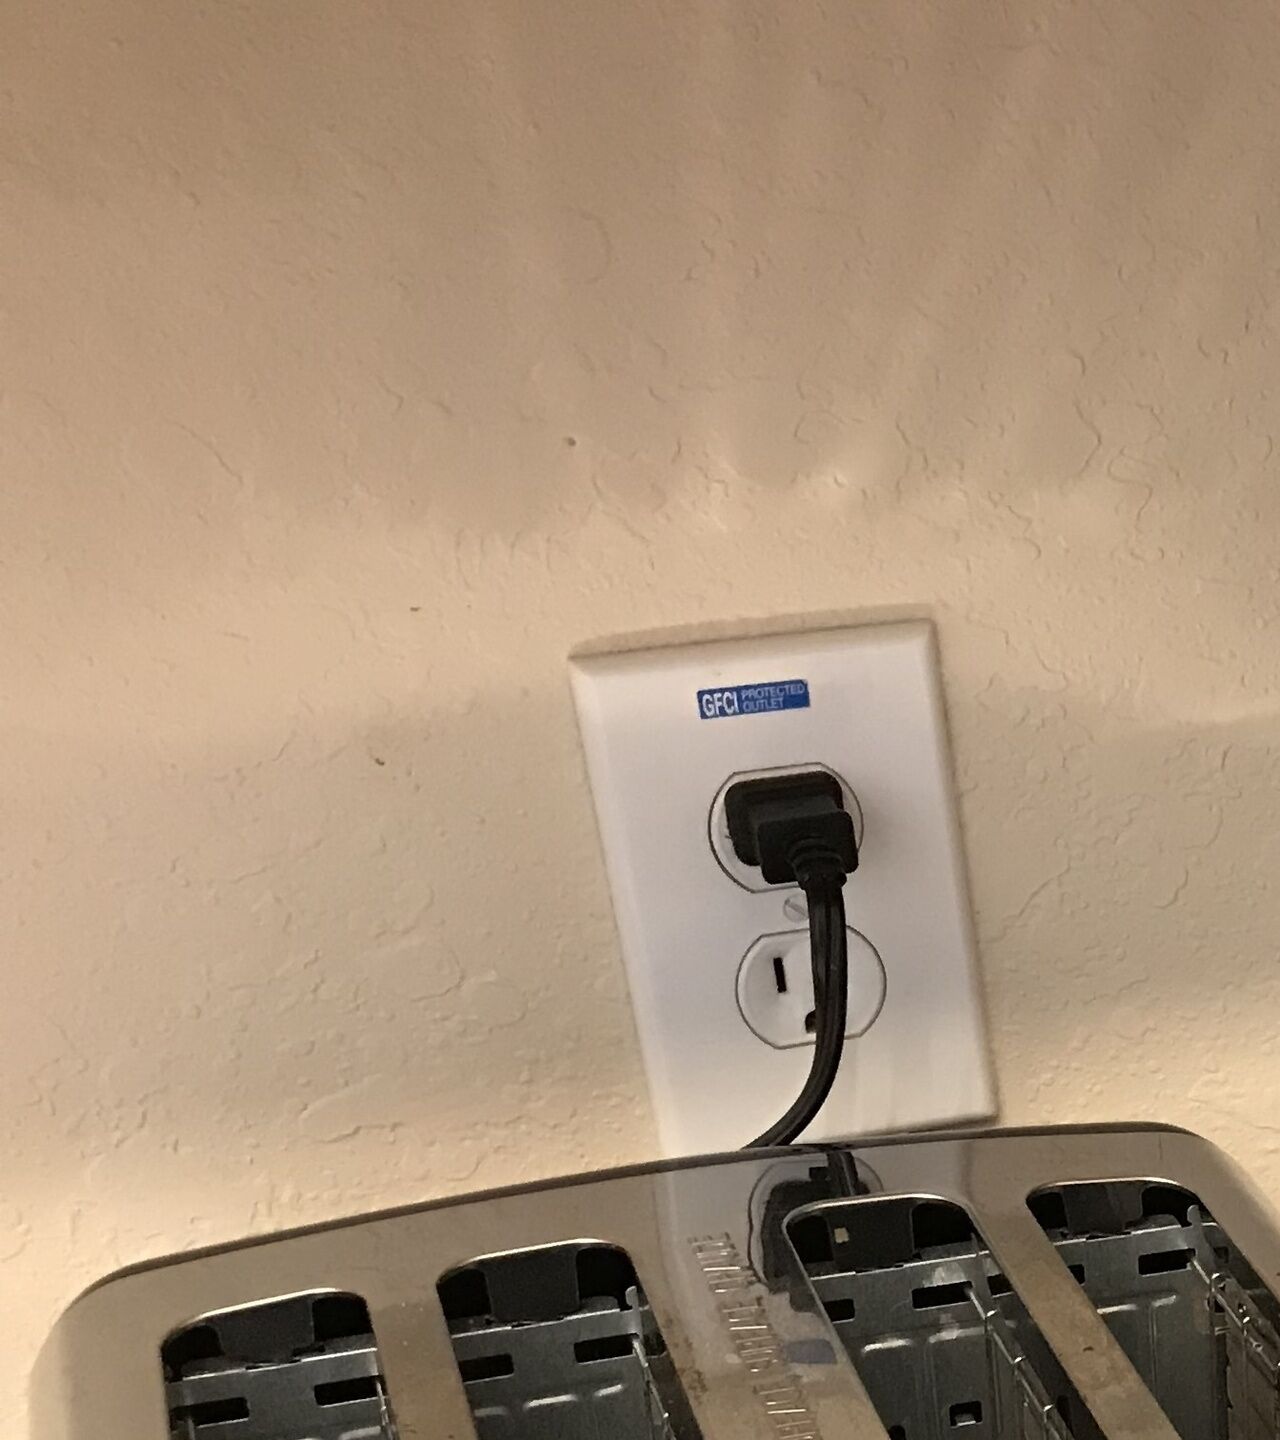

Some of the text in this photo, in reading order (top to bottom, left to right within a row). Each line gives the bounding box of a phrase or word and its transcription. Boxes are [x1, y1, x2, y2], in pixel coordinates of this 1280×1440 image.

[702, 683, 805, 717] GFCI PROTECTED
[742, 698, 784, 712] OUTLET
